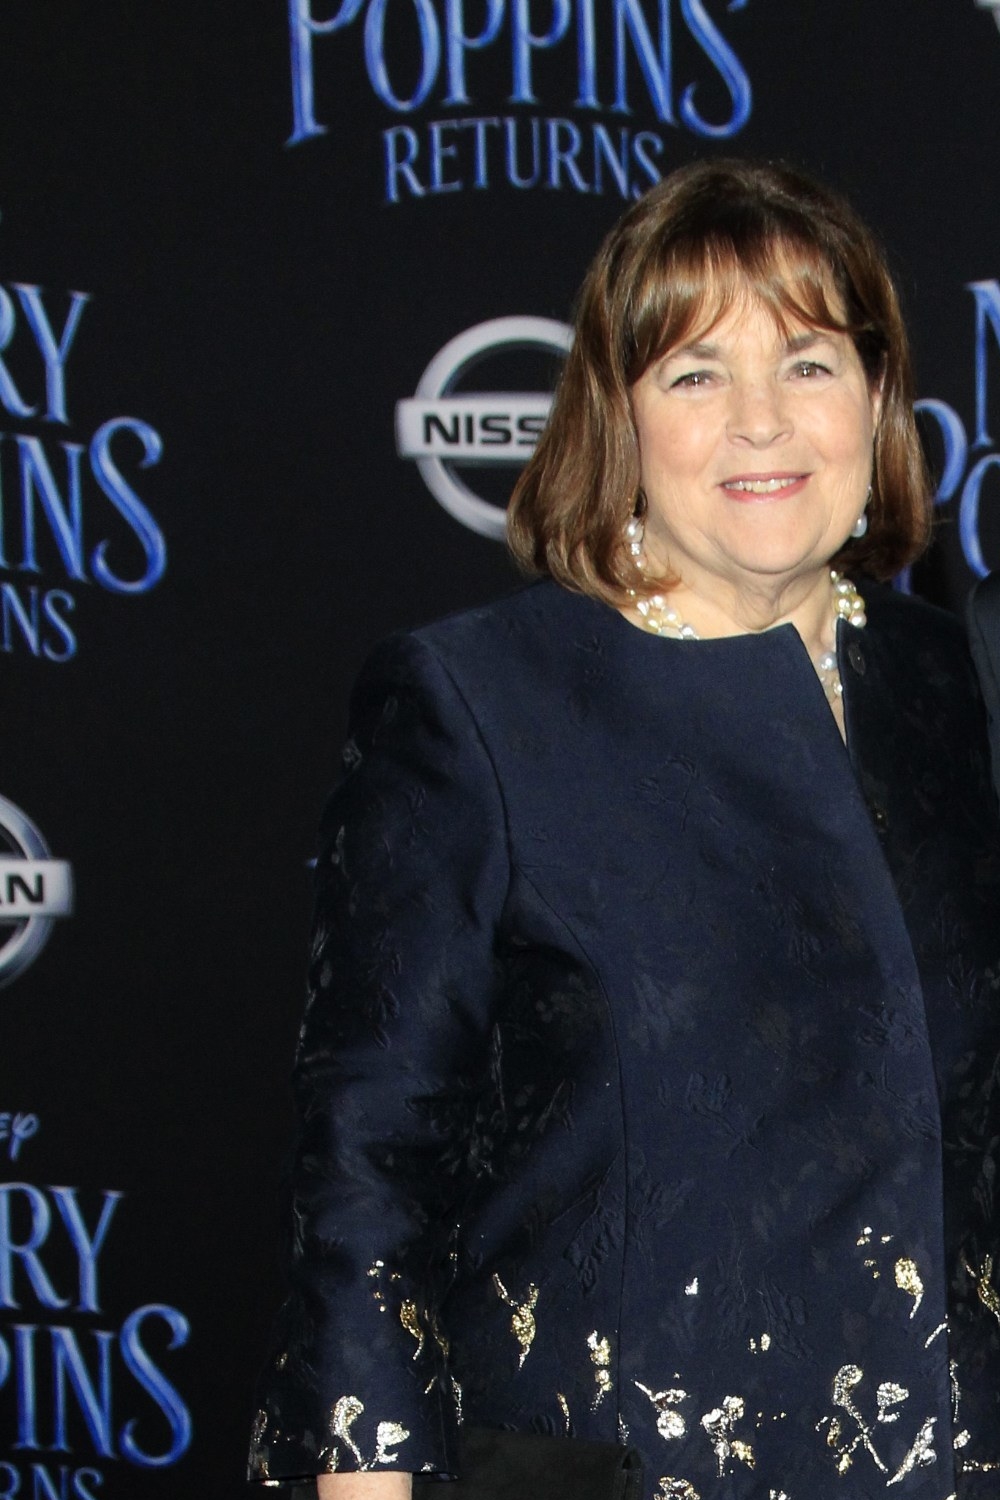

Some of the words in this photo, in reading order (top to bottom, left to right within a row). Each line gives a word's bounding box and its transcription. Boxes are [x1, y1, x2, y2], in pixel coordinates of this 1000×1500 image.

[285, 0, 753, 143] POPPINS
[382, 116, 665, 202] RETURNS
[422, 412, 548, 446] NISS
[0, 1181, 124, 1313] RY
